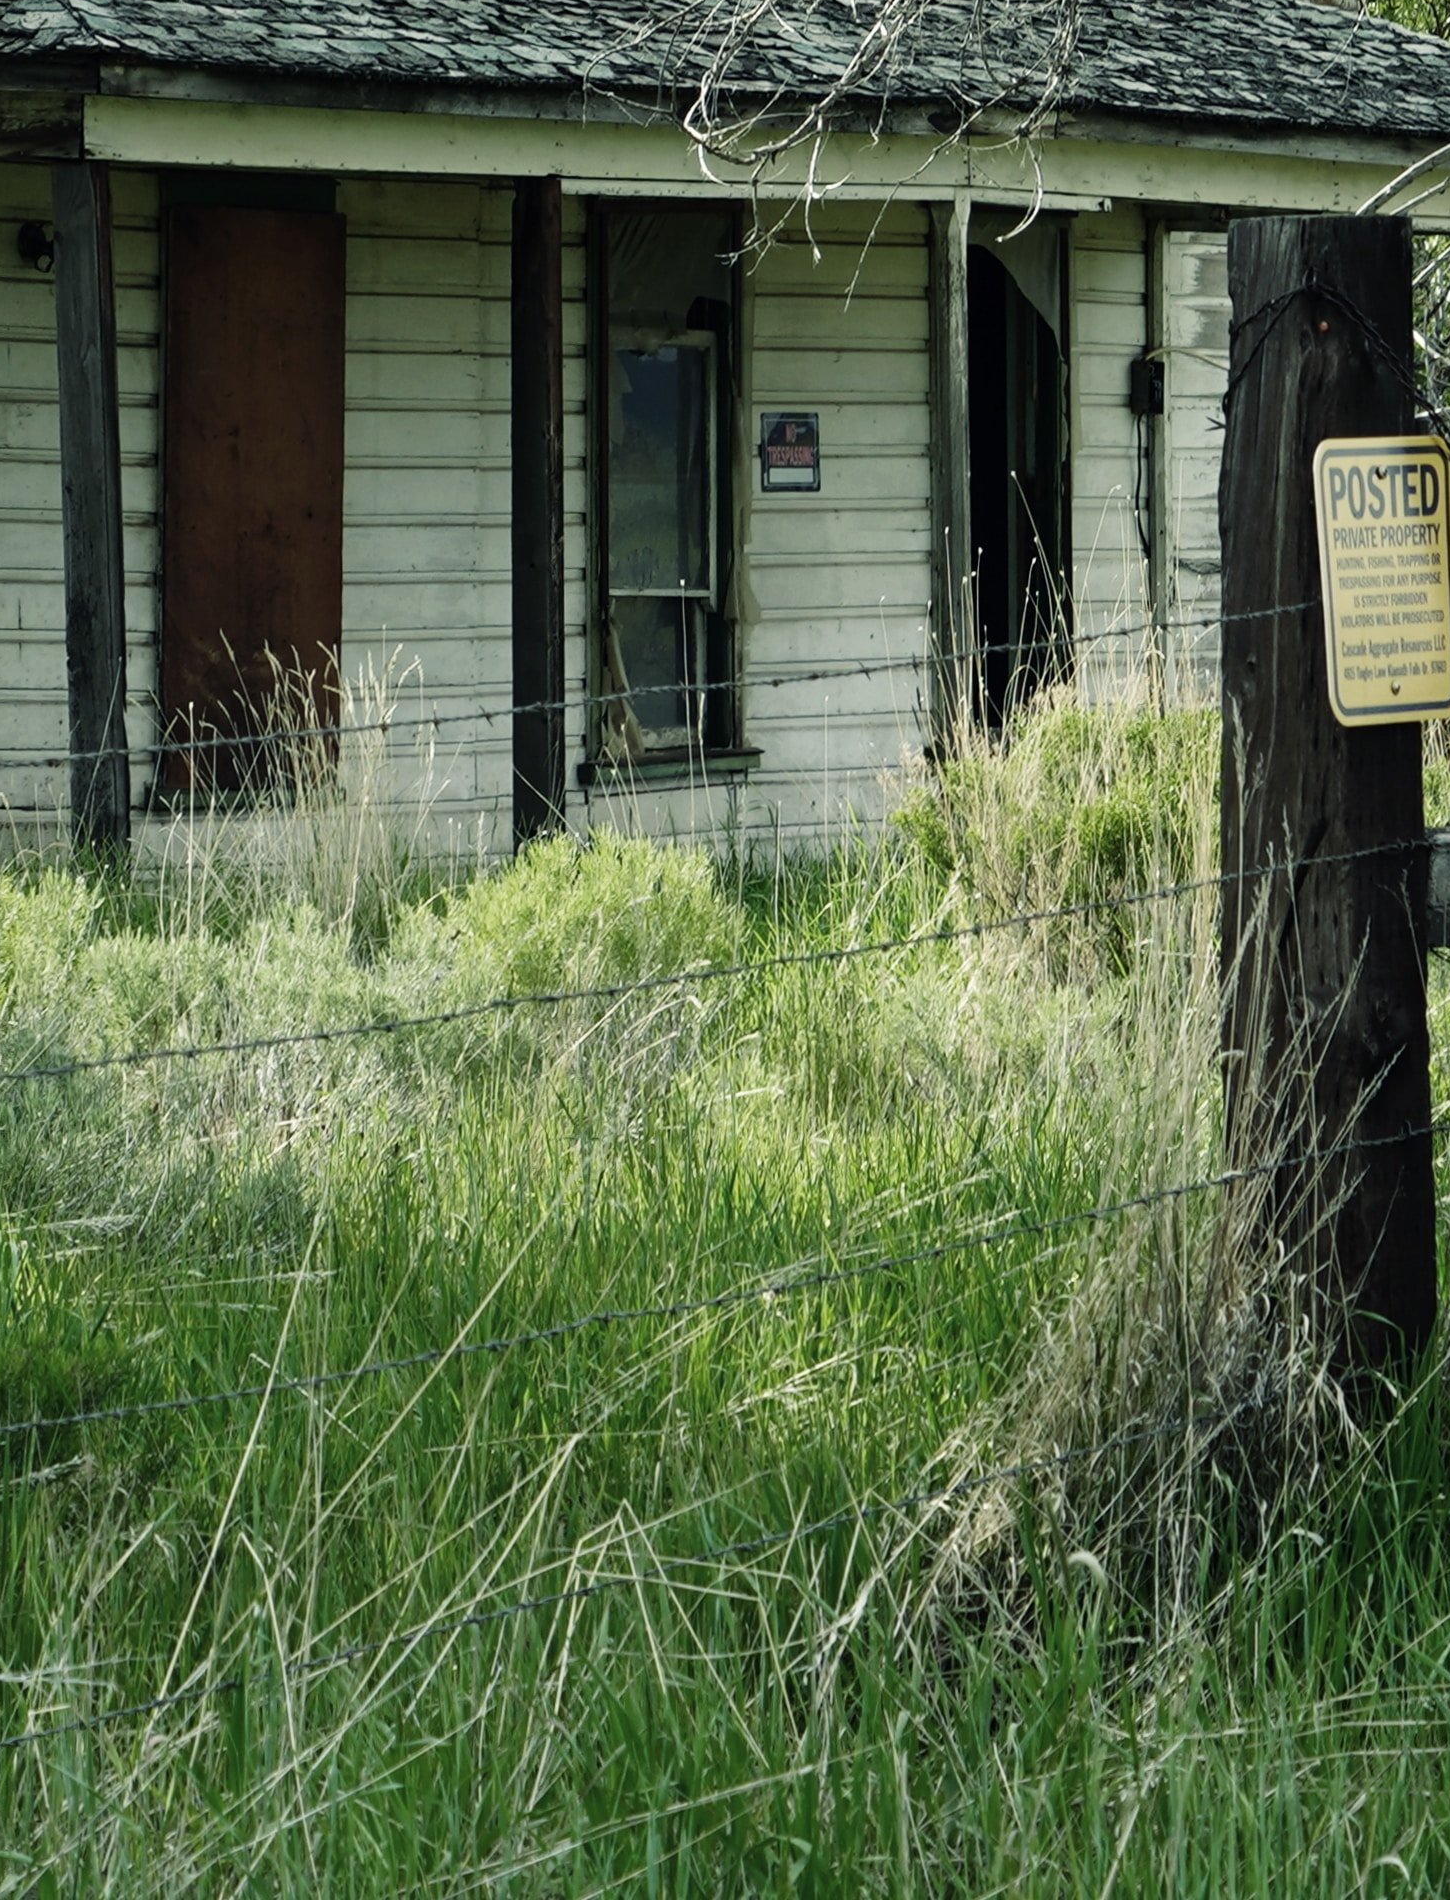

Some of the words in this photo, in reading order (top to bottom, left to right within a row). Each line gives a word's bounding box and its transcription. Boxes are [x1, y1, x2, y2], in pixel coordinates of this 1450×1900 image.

[785, 422, 797, 443] NO
[767, 445, 814, 465] TRESPASSING
[1329, 464, 1440, 521] POSTED
[1333, 526, 1378, 550] PRIVATE
[1380, 524, 1441, 548] PROPERTY
[1336, 557, 1366, 571] HUNTING,
[1397, 554, 1430, 567] TRAPPING
[1431, 552, 1441, 565] OR
[1338, 576, 1382, 590] TRESPASSING
[1383, 575, 1396, 587] FOR
[1397, 574, 1410, 586] ANY
[1410, 572, 1442, 585] PURPOSE
[1353, 595, 1361, 608] IS
[1361, 594, 1389, 608] STRICTLY
[1390, 592, 1428, 606] FORBIDDEN
[1340, 614, 1375, 628] VIOLATORS
[1375, 613, 1390, 626] WILL
[1392, 612, 1401, 625] BE
[1402, 610, 1444, 624] PROSECUTED
[1342, 641, 1366, 657] Cascade
[1369, 638, 1399, 659] Aggregate
[1400, 636, 1433, 654] Resources
[1434, 633, 1446, 651] LLC
